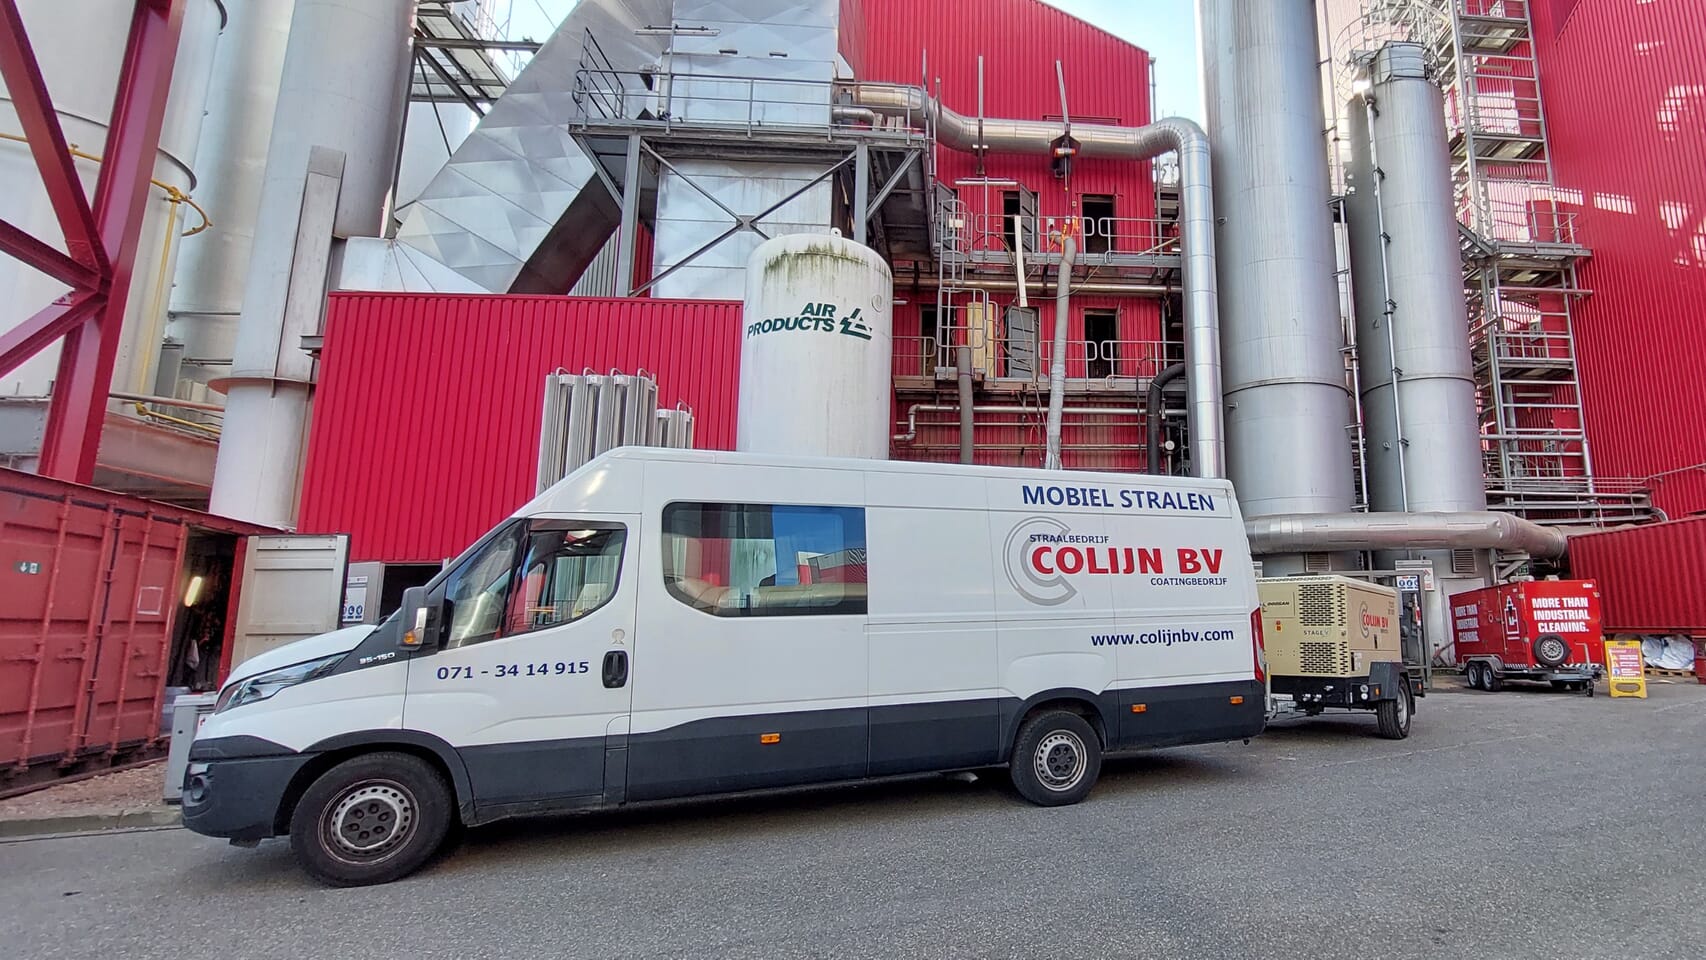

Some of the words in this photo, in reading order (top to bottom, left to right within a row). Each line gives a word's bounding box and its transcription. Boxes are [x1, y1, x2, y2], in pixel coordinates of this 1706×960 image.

[800, 302, 837, 317] AIR
[747, 316, 836, 339] PRODUCTS
[1022, 485, 1114, 508] MOBIEL
[1120, 489, 1215, 511] STRALEN
[1029, 534, 1109, 544] STRAALBEDRIJF
[1031, 546, 1164, 575] COLIJN
[1177, 548, 1223, 575] BV
[1150, 577, 1228, 586] COATINGBEDRIJF
[1532, 597, 1560, 608] MORE
[1561, 597, 1588, 608] THAN
[1533, 609, 1591, 620] INDUSTRIAL
[1538, 621, 1590, 632] CLEANING.
[1091, 629, 1234, 647] www.colijnbv.com
[437, 666, 473, 680] 071
[495, 665, 519, 677] 34
[526, 663, 549, 676] 14
[555, 661, 590, 675] 915
